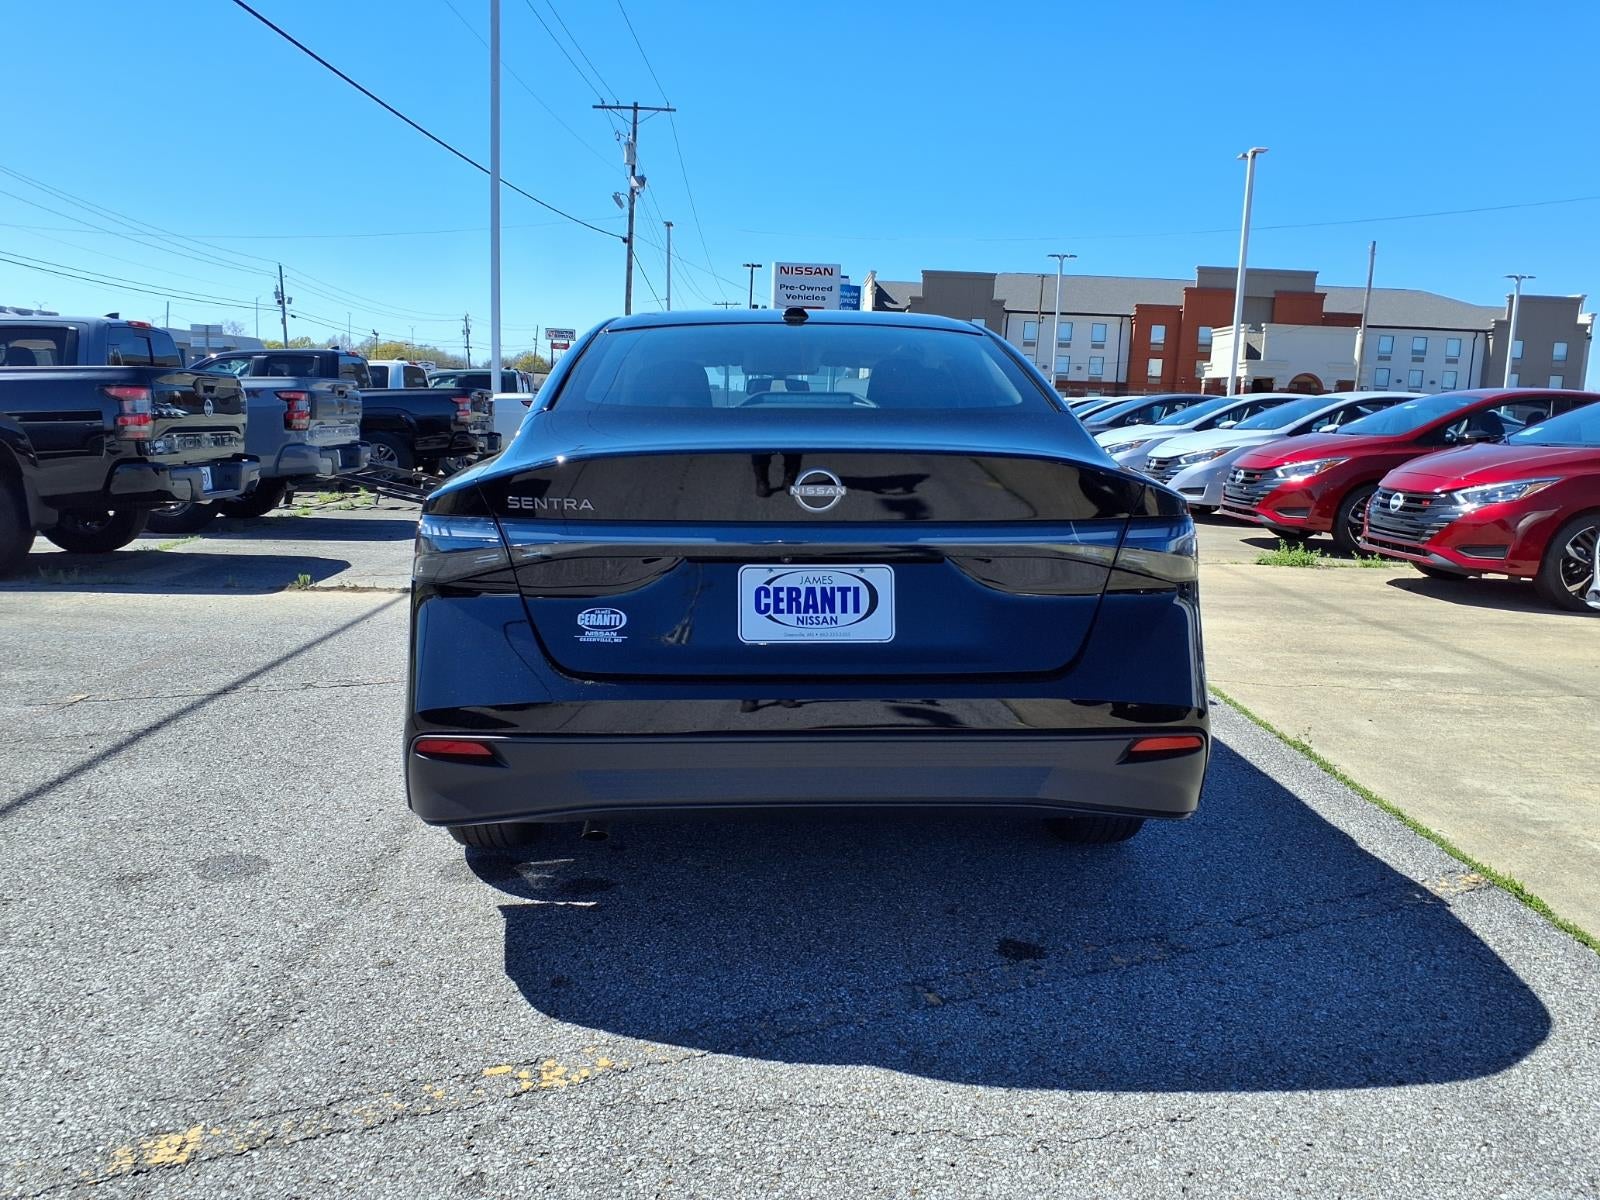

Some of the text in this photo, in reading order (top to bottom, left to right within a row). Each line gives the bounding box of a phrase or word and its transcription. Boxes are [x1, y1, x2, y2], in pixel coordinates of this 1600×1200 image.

[780, 266, 833, 276] NISSAN
[780, 284, 833, 292] Pre-Owned
[785, 293, 826, 302] Vehicles
[791, 487, 845, 495] NISSAN
[507, 496, 595, 511] SENTRA
[799, 576, 833, 585] JAMES
[754, 586, 860, 615] CERANTI
[577, 613, 620, 626] CERANTI
[796, 615, 838, 626] NISSAN
